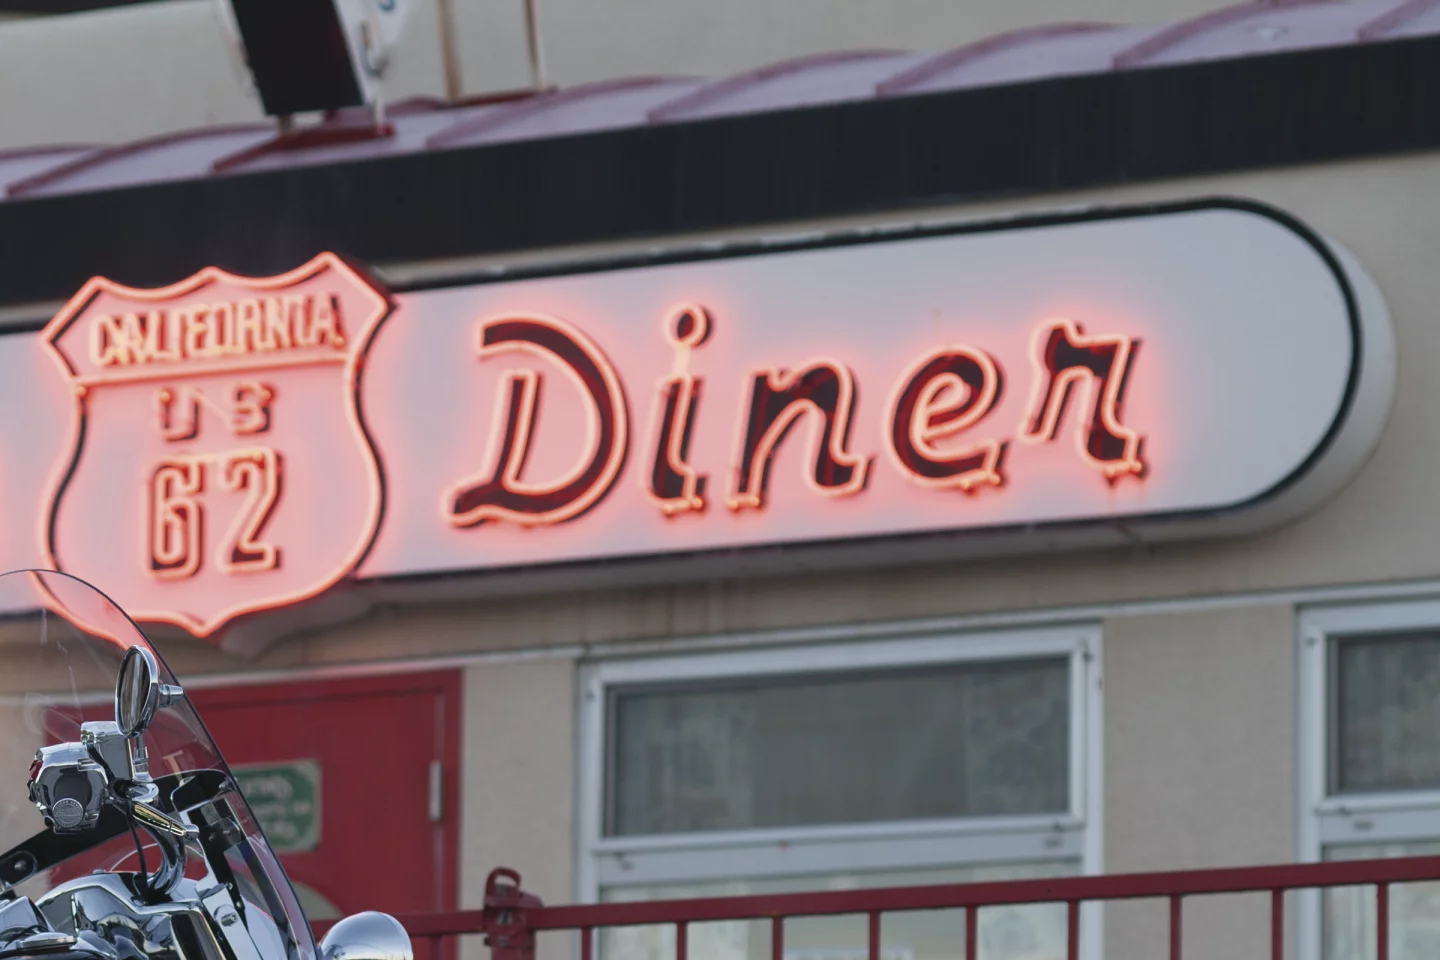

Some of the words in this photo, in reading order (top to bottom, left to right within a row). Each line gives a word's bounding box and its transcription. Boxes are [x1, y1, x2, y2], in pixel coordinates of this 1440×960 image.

[89, 292, 346, 367] CALIFORNIA
[443, 303, 1149, 528] Diner
[142, 445, 283, 581] 62
